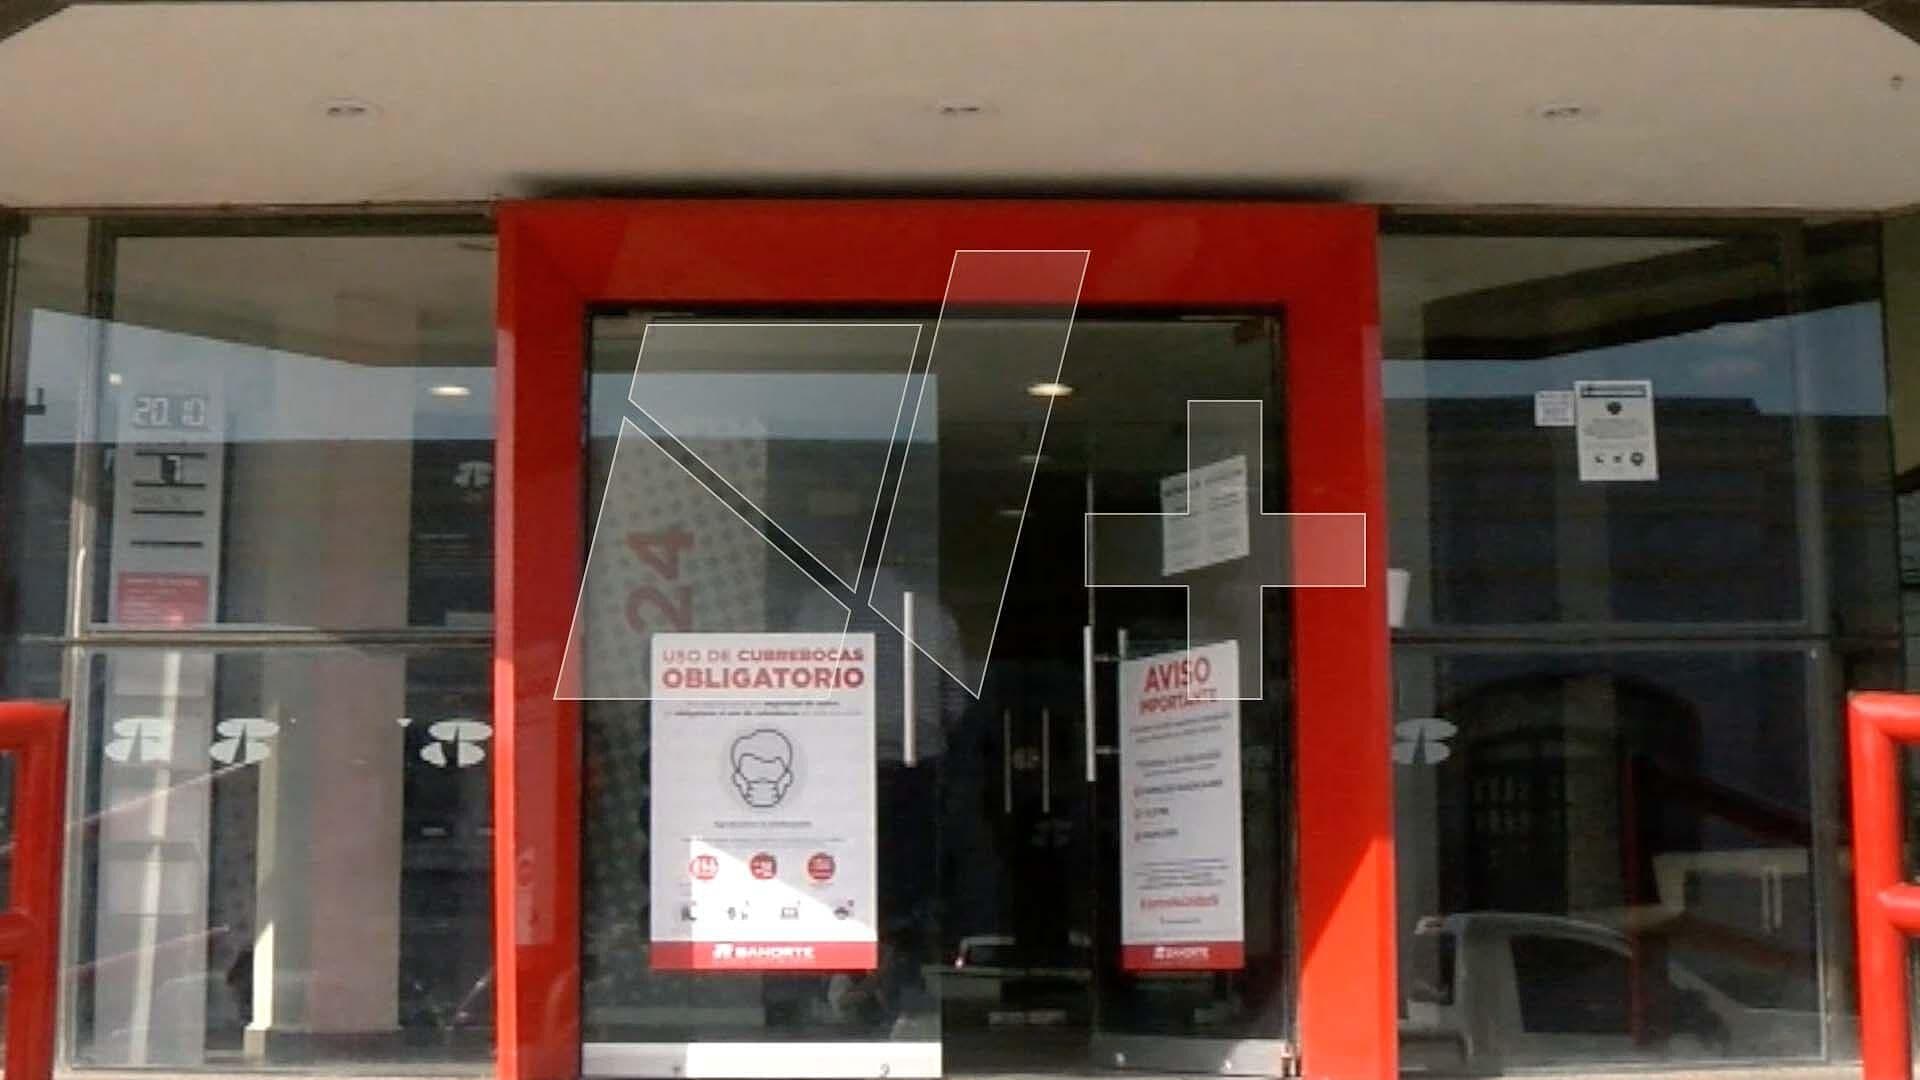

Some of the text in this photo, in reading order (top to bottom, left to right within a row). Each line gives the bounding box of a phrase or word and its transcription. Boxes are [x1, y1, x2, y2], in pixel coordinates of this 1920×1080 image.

[625, 528, 695, 634] 24
[662, 647, 864, 662] USO DE CUBREBOCAS
[662, 666, 865, 689] OBLIGATORIO
[1143, 656, 1211, 694] AVISO
